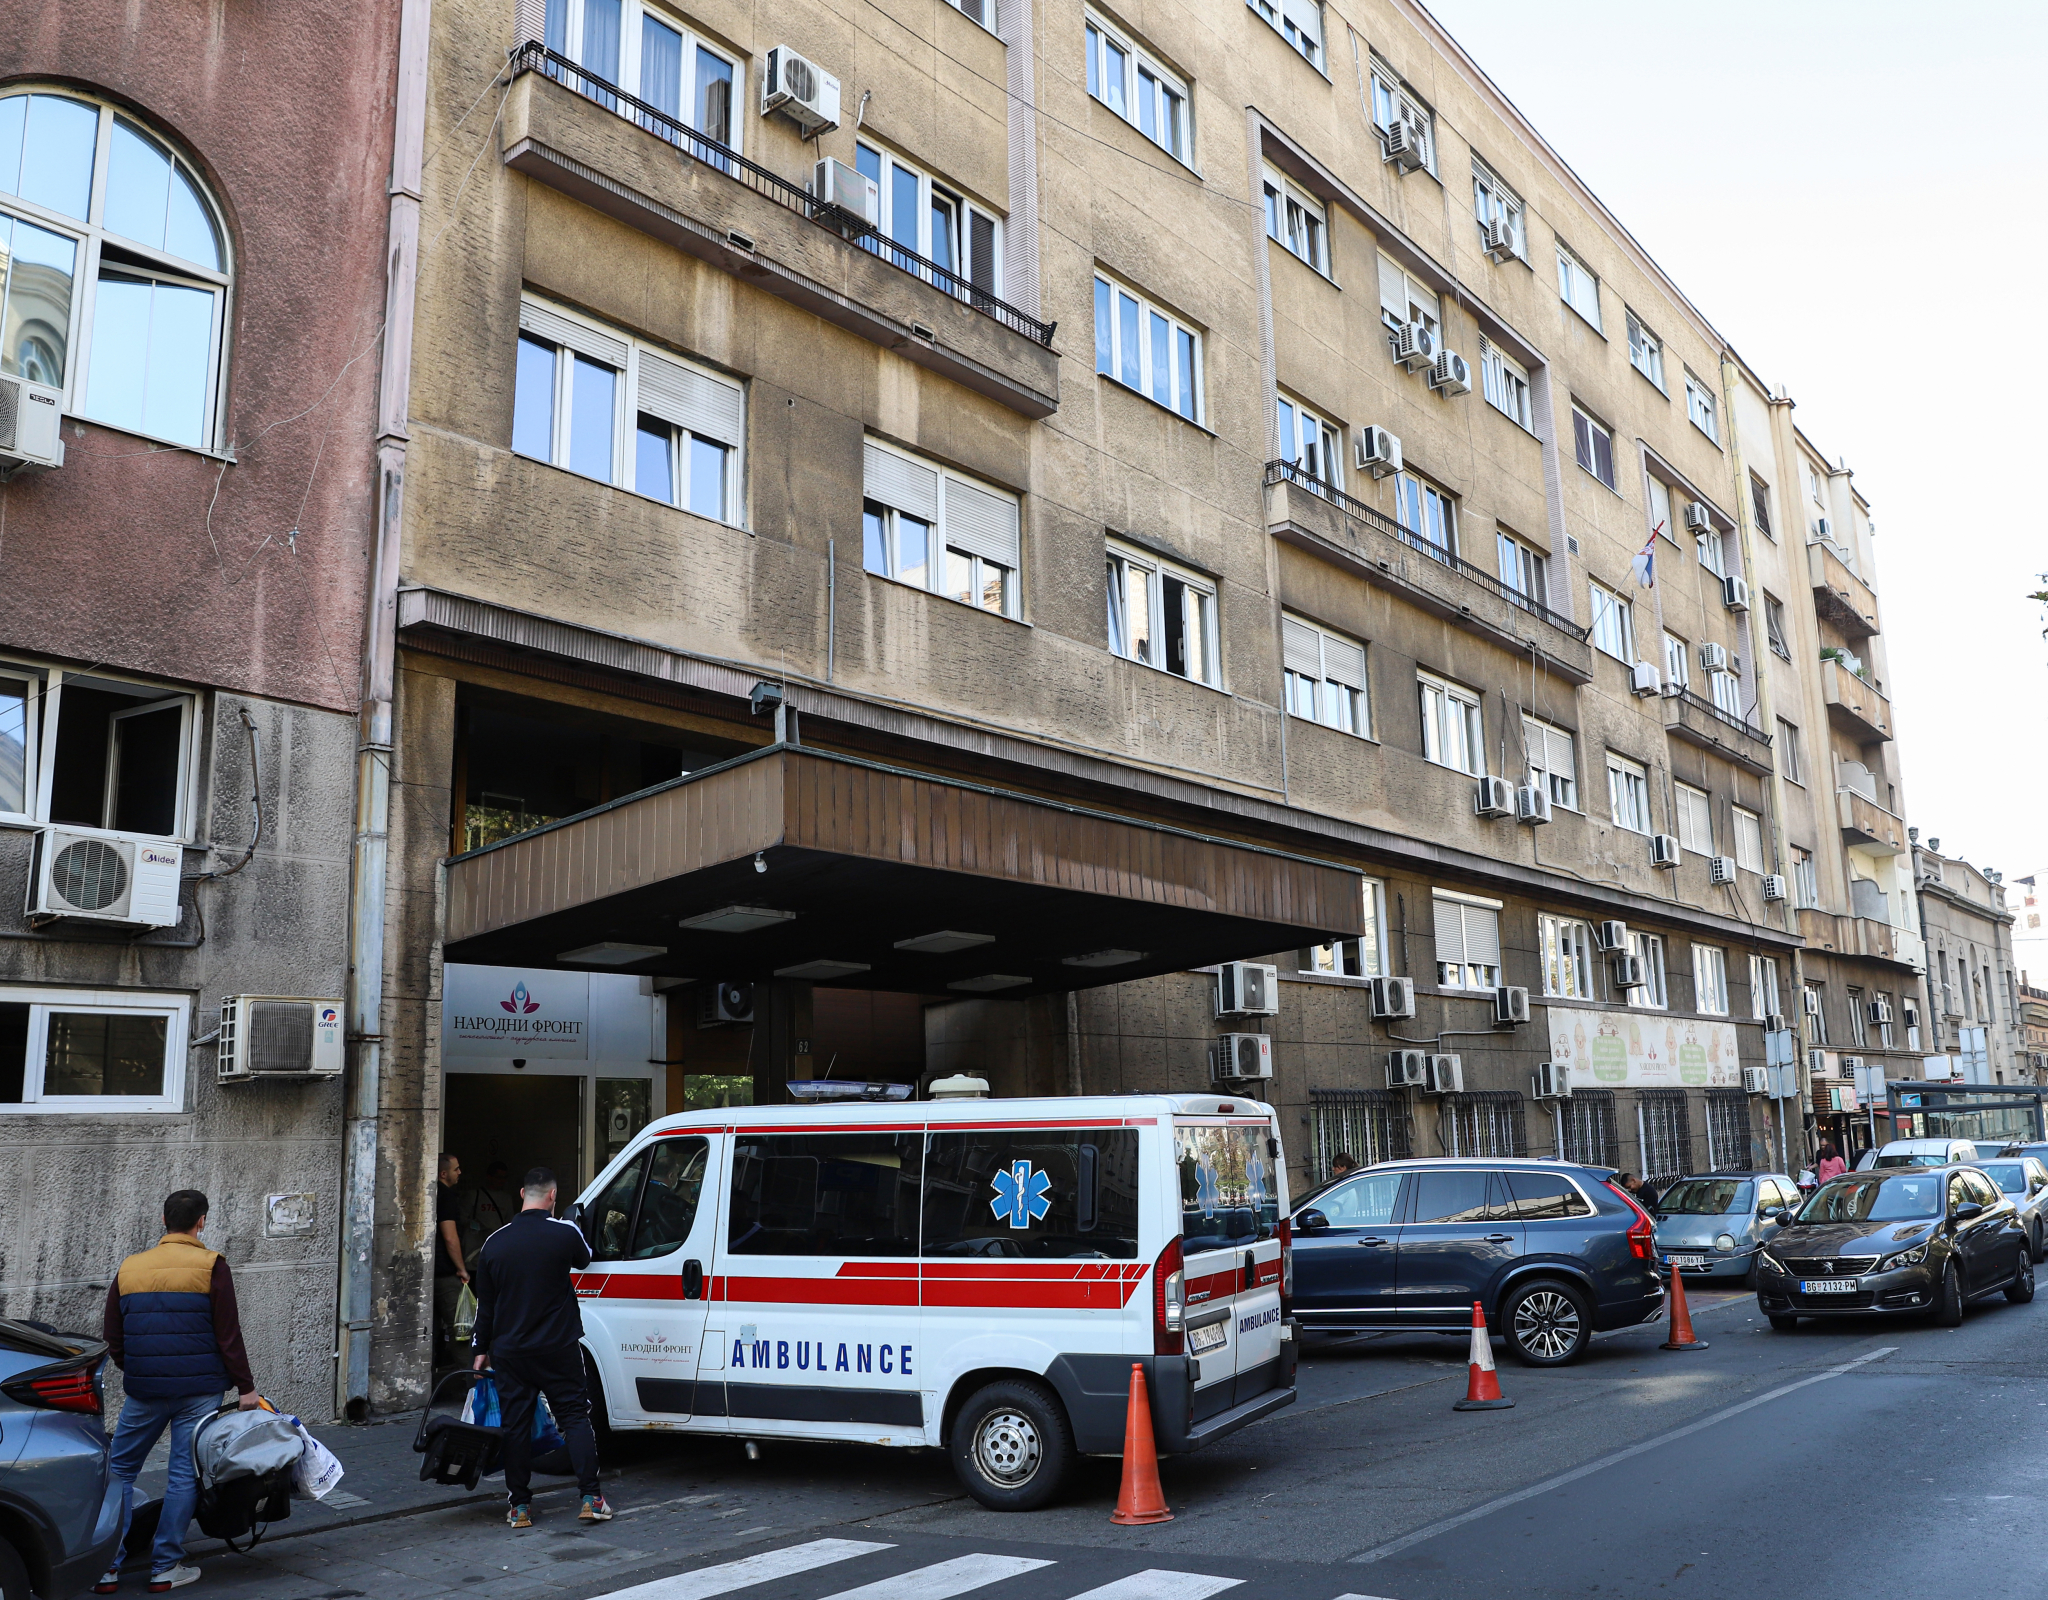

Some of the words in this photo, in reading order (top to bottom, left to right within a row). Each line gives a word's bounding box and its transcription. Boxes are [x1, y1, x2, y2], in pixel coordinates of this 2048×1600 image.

[30, 393, 55, 405] TESLA
[147, 853, 176, 864] Midea
[453, 1016, 528, 1034] НАРОДНИ
[532, 1020, 582, 1034] ФРОНТ
[798, 1041, 809, 1053] 62
[1806, 1283, 1816, 1291] BG
[1239, 1307, 1280, 1334] AMBULANCE
[621, 1343, 661, 1354] НАРОДНИ
[662, 1345, 693, 1354] ФРОНТ
[731, 1339, 912, 1375] AMBULANCE
[318, 1463, 336, 1485] ACTION
